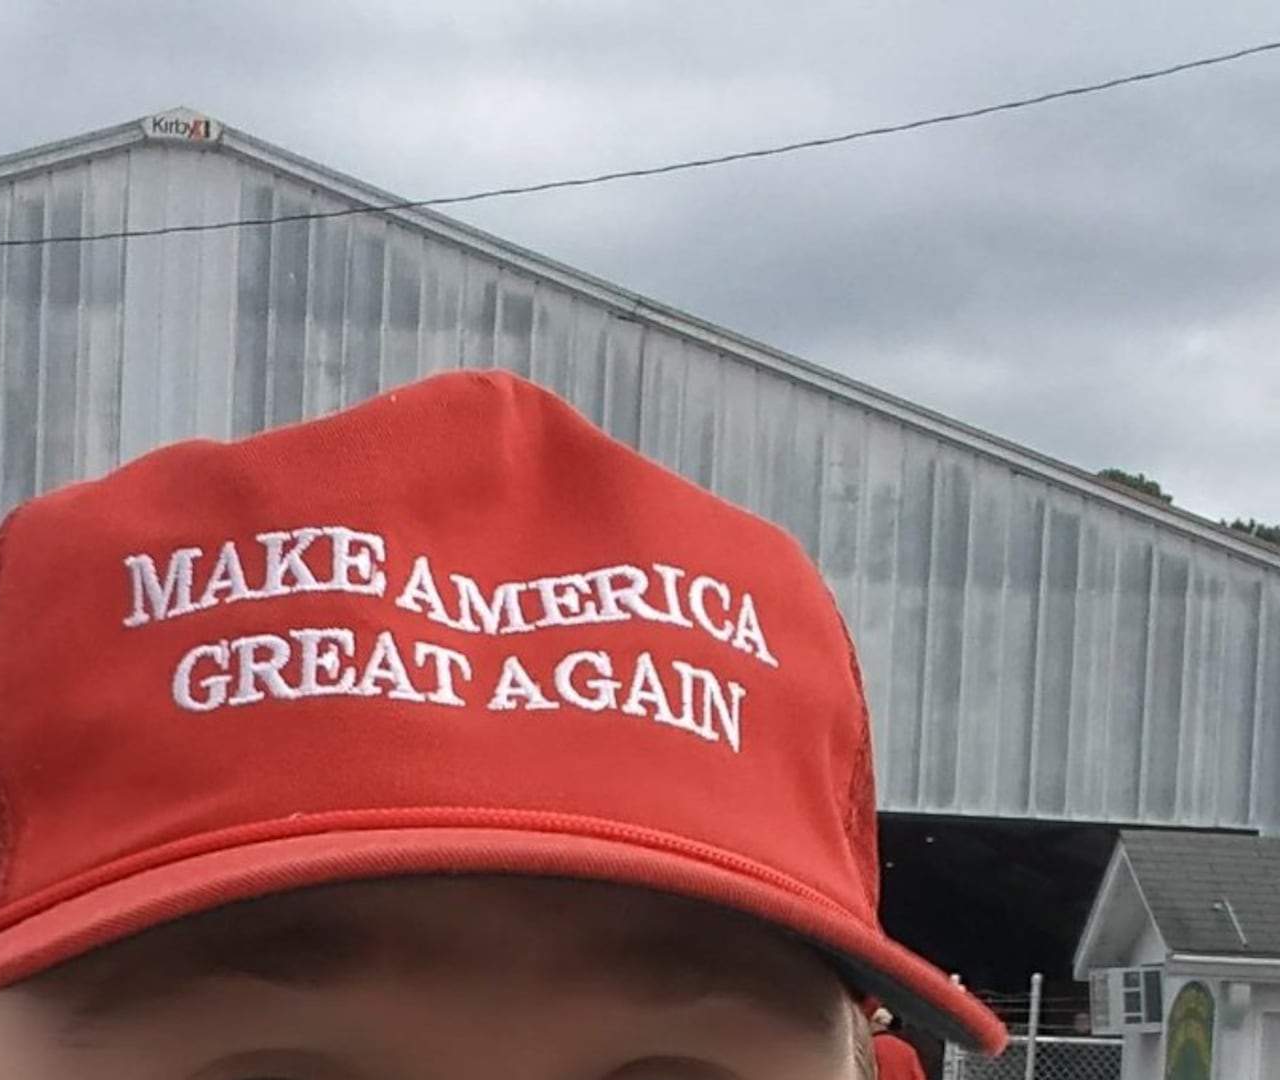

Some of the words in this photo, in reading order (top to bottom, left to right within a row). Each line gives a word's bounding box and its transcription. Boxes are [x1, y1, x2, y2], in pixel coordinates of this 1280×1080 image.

[152, 116, 195, 138] Kirby
[123, 525, 387, 630] MAKE
[395, 555, 779, 667] AMERICA
[171, 627, 472, 712] GREAT
[487, 652, 747, 753] AGAIN
